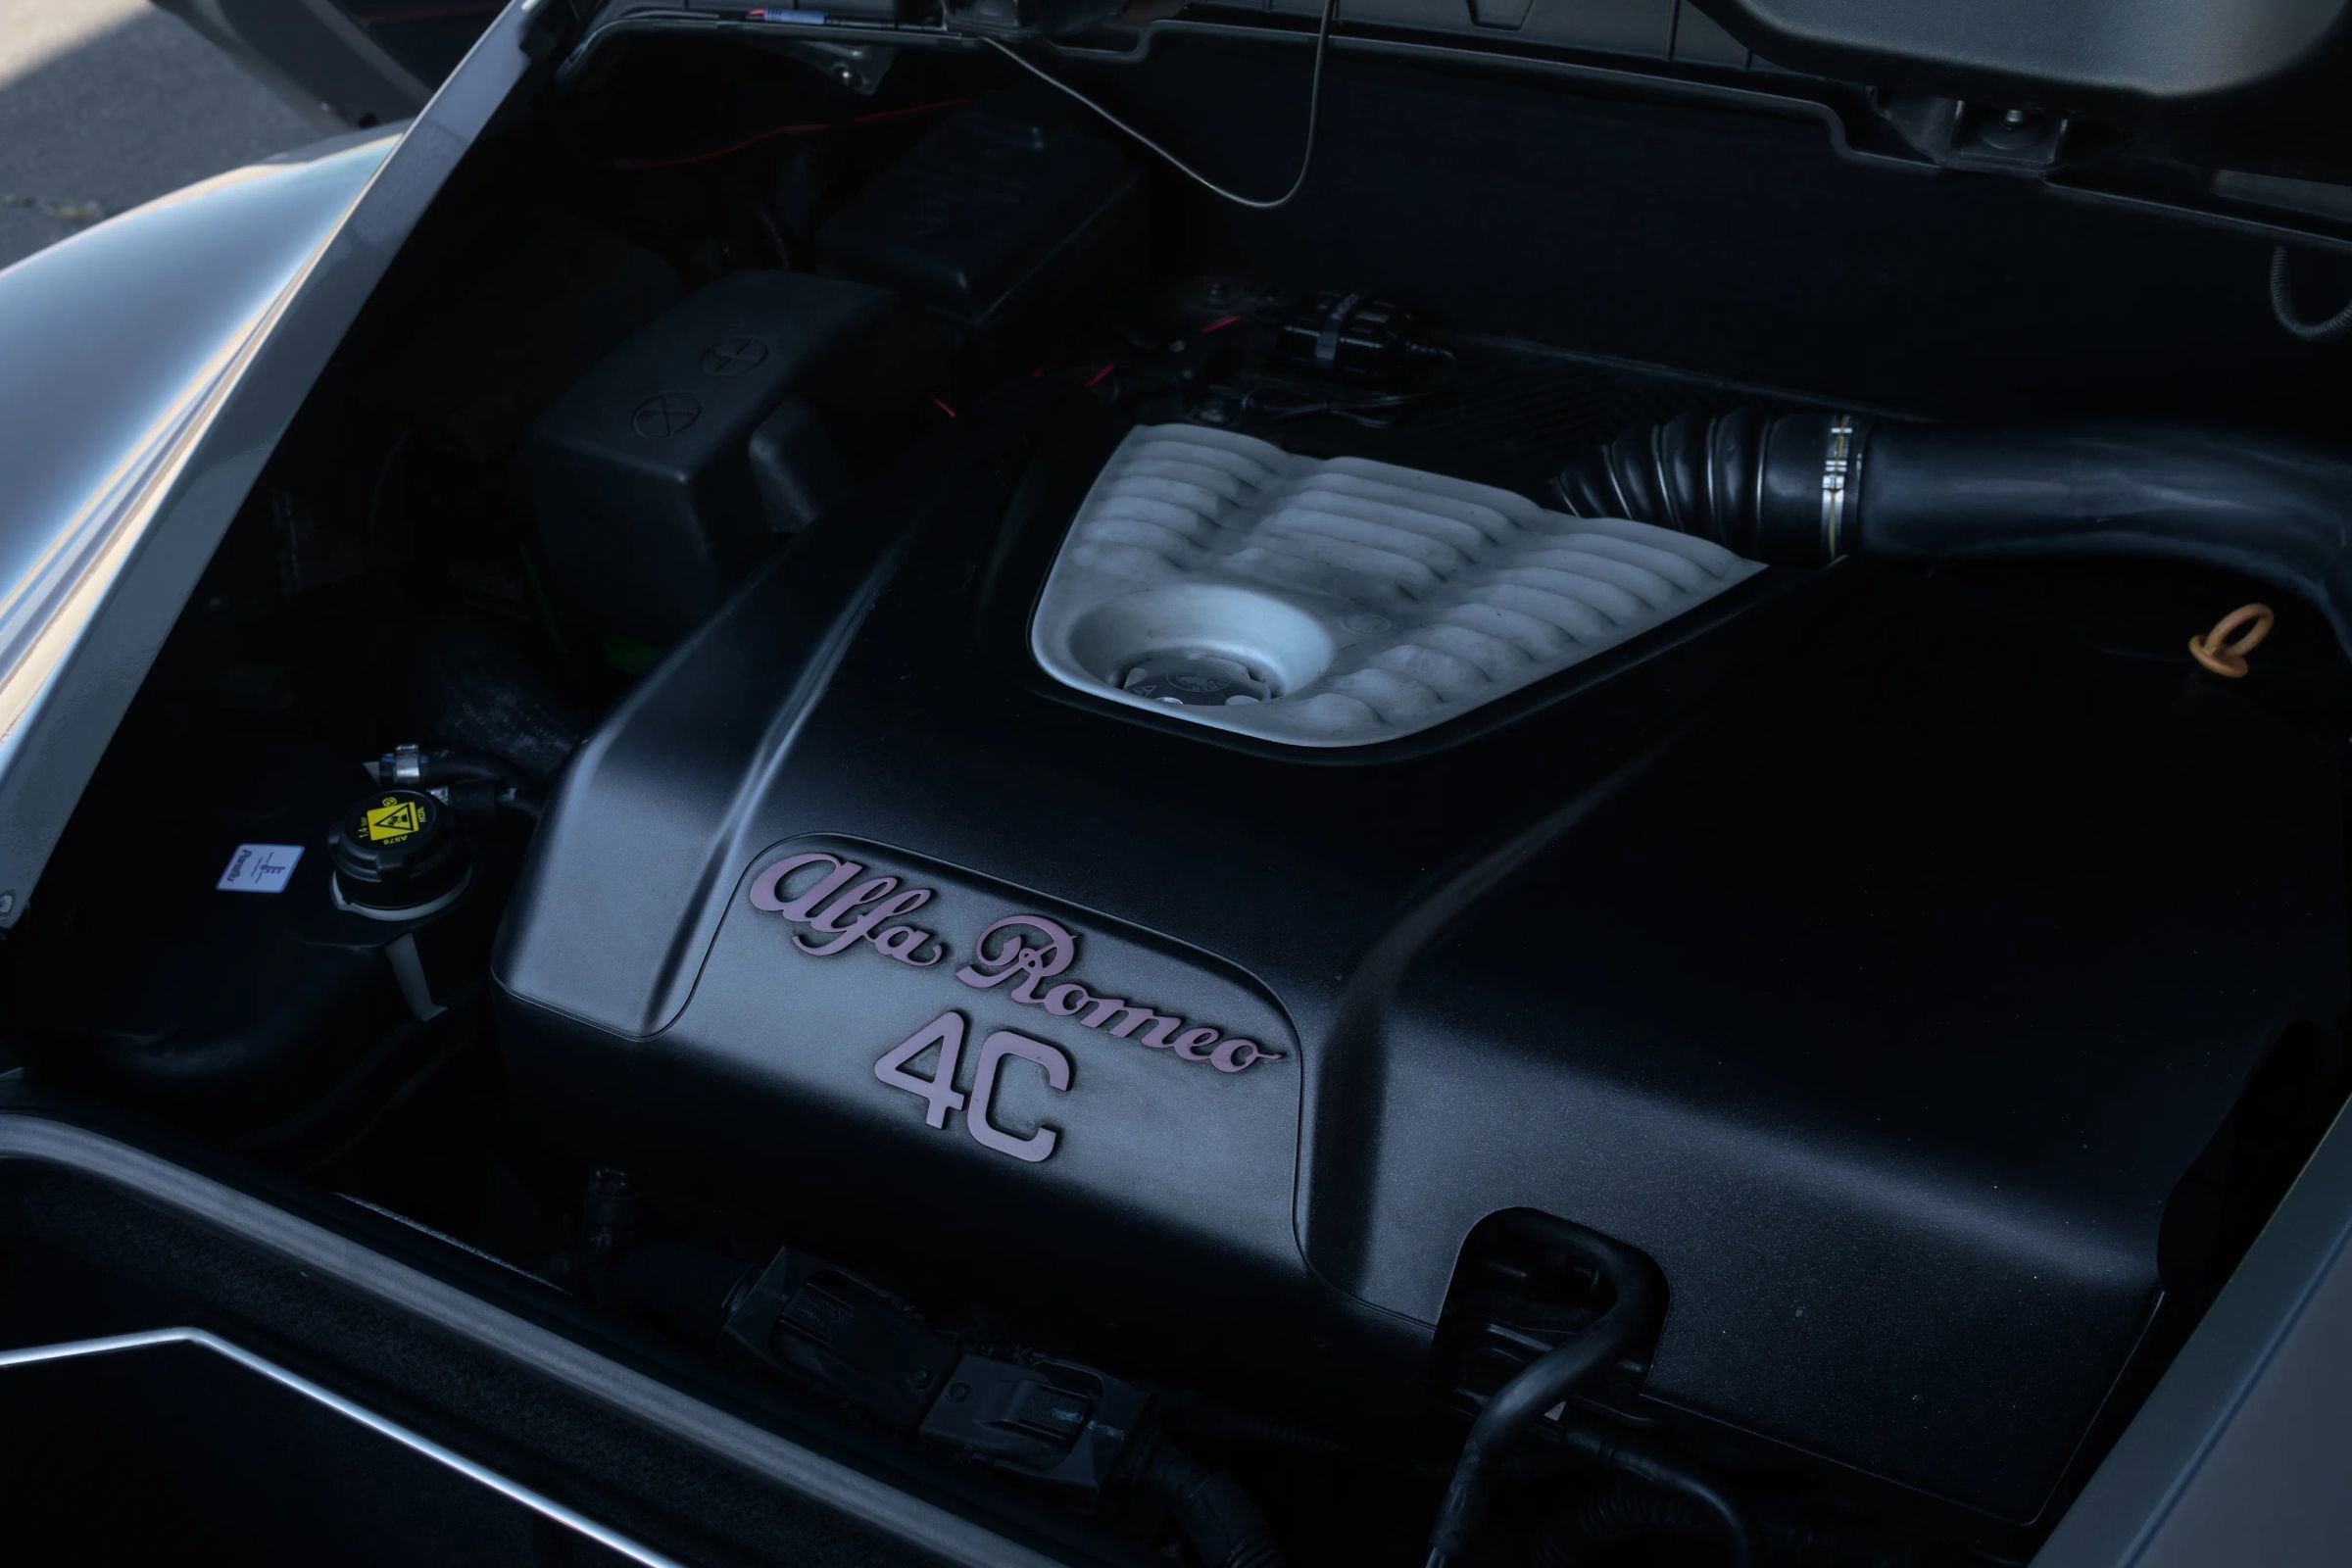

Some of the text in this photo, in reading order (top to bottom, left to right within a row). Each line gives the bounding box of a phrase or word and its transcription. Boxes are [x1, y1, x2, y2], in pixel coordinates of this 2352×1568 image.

[749, 852, 1288, 1075] Alfa Romeo
[873, 1009, 1075, 1164] 4C
